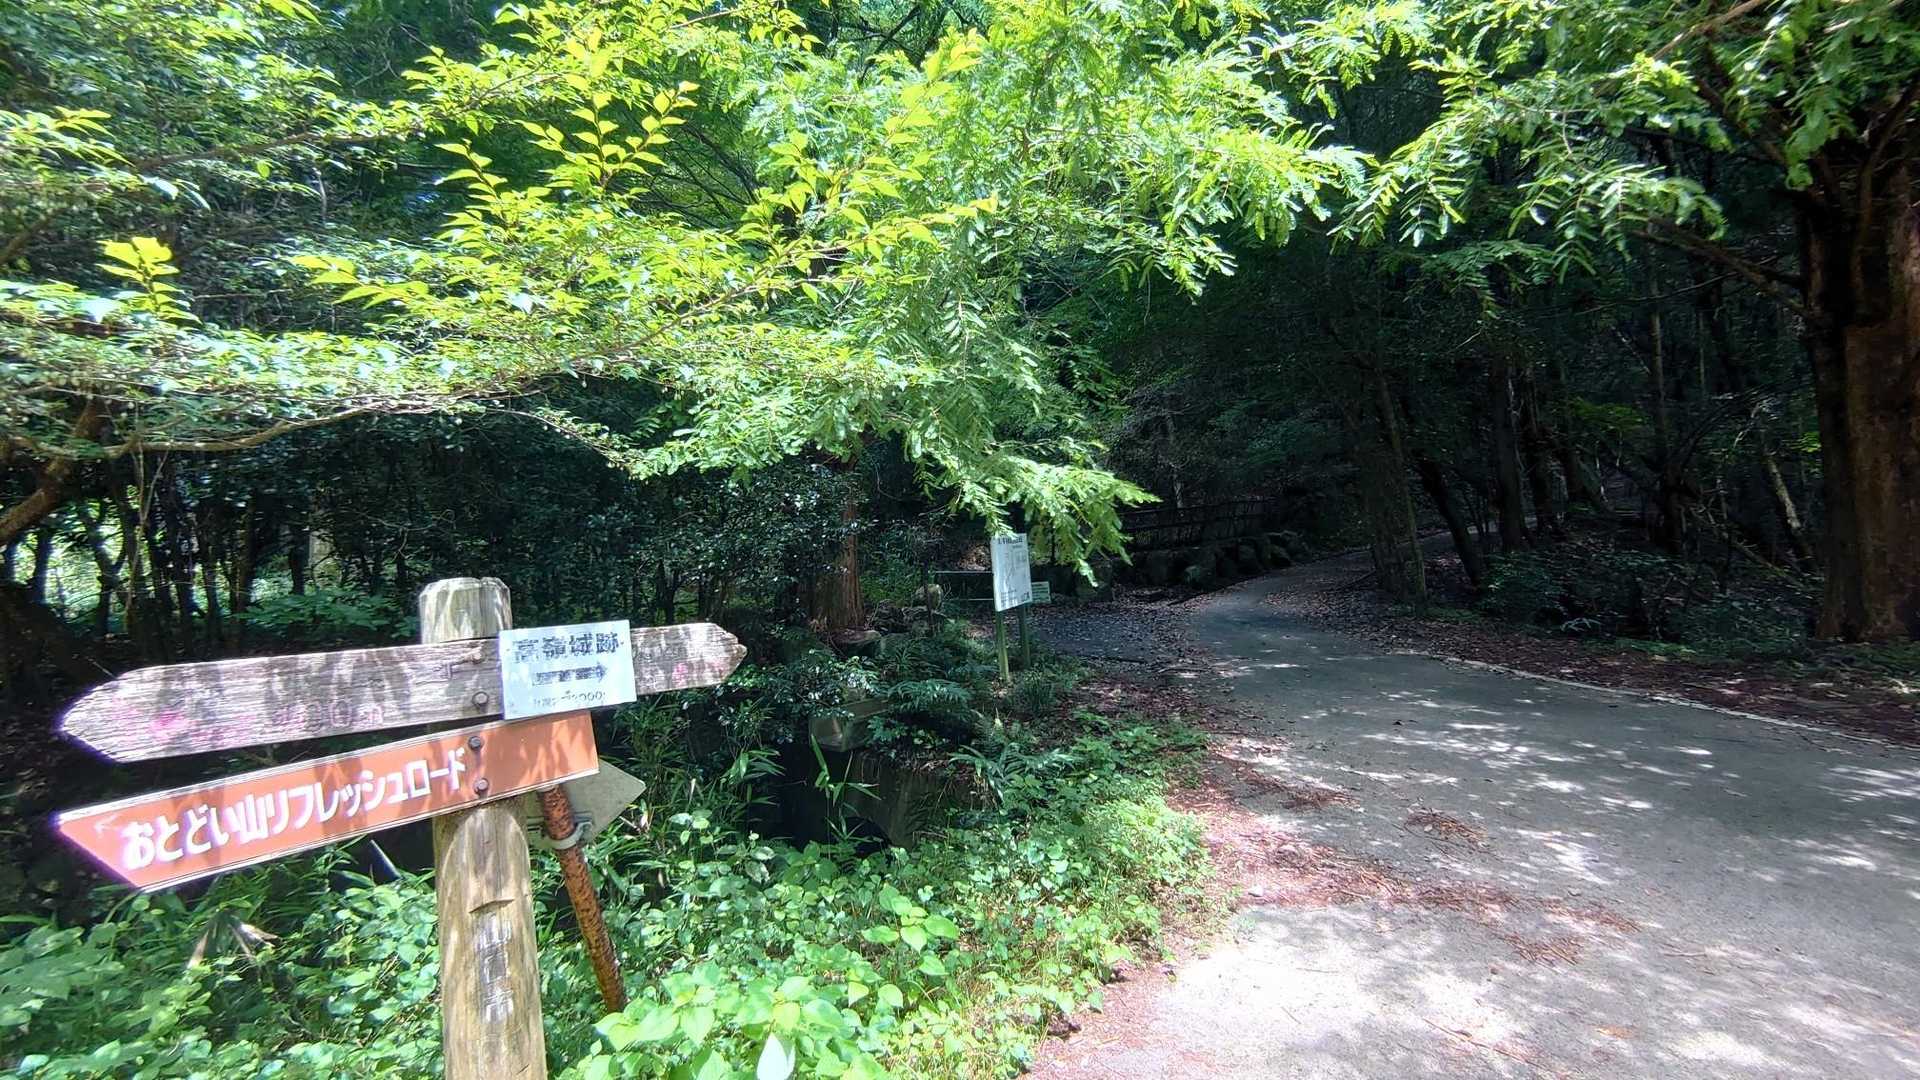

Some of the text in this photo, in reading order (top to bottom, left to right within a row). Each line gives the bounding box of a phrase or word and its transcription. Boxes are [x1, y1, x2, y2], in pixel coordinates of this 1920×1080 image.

[122, 746, 467, 871] おとどい山リフレッシュロード
